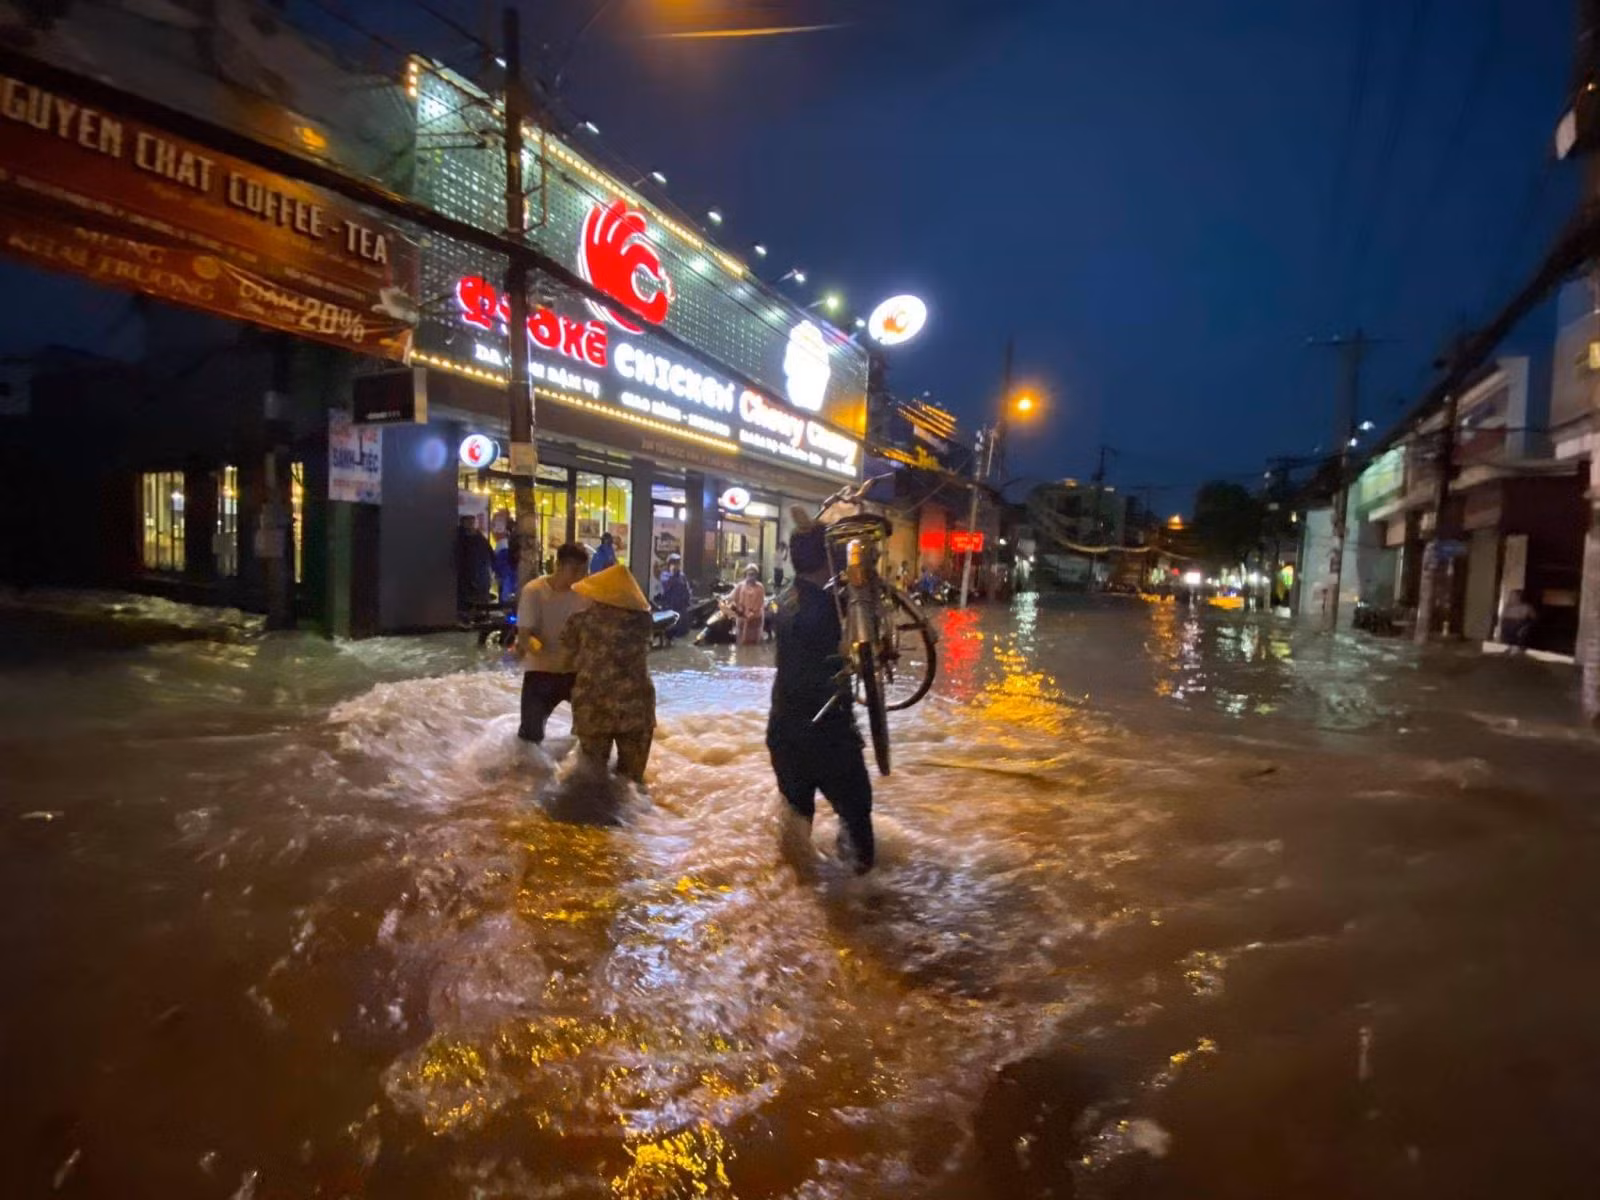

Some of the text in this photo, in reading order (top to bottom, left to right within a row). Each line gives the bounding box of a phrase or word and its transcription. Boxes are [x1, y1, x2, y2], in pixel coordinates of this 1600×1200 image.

[229, 170, 324, 238] COFFEE
[345, 218, 388, 265] TEA
[300, 298, 365, 343] 20%
[614, 343, 736, 413] CHICKEN
